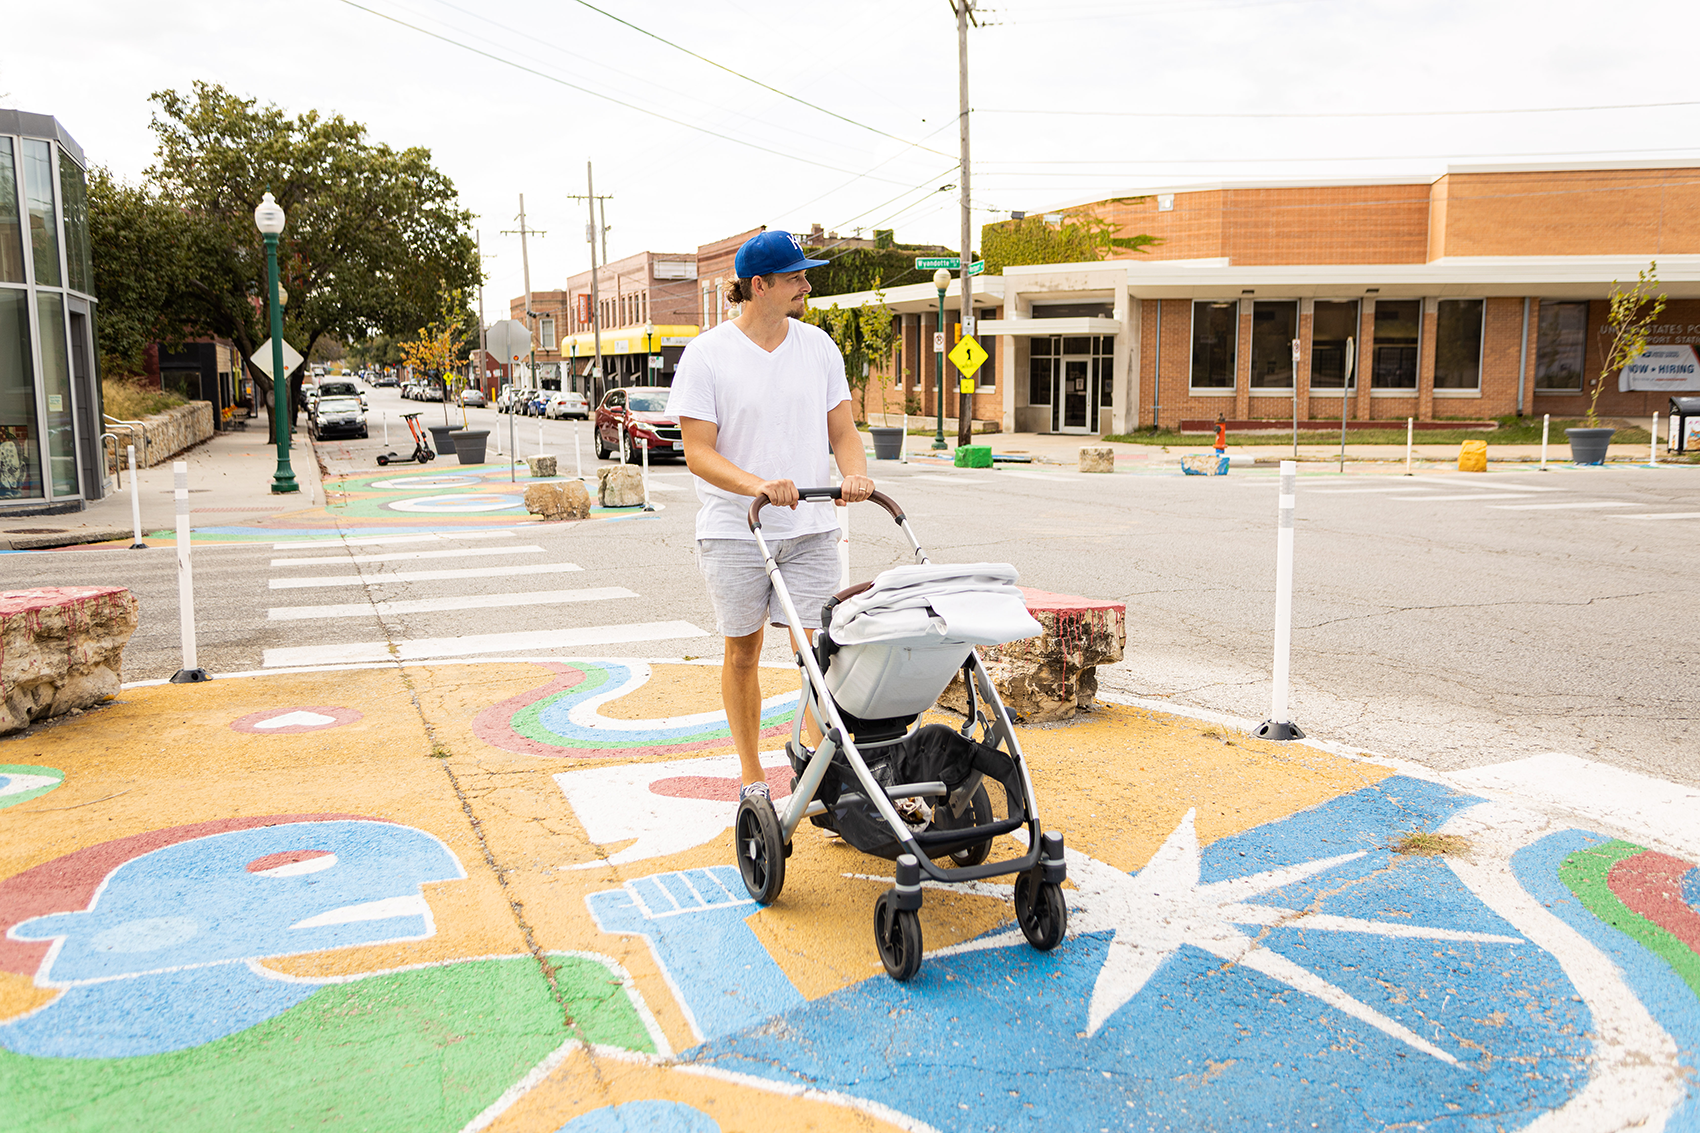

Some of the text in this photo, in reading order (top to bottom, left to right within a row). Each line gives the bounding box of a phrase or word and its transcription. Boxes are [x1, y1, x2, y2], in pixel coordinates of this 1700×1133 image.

[917, 259, 950, 268] Wyandotte
[1645, 324, 1684, 334] STATES
[1658, 364, 1695, 374] HIRING
